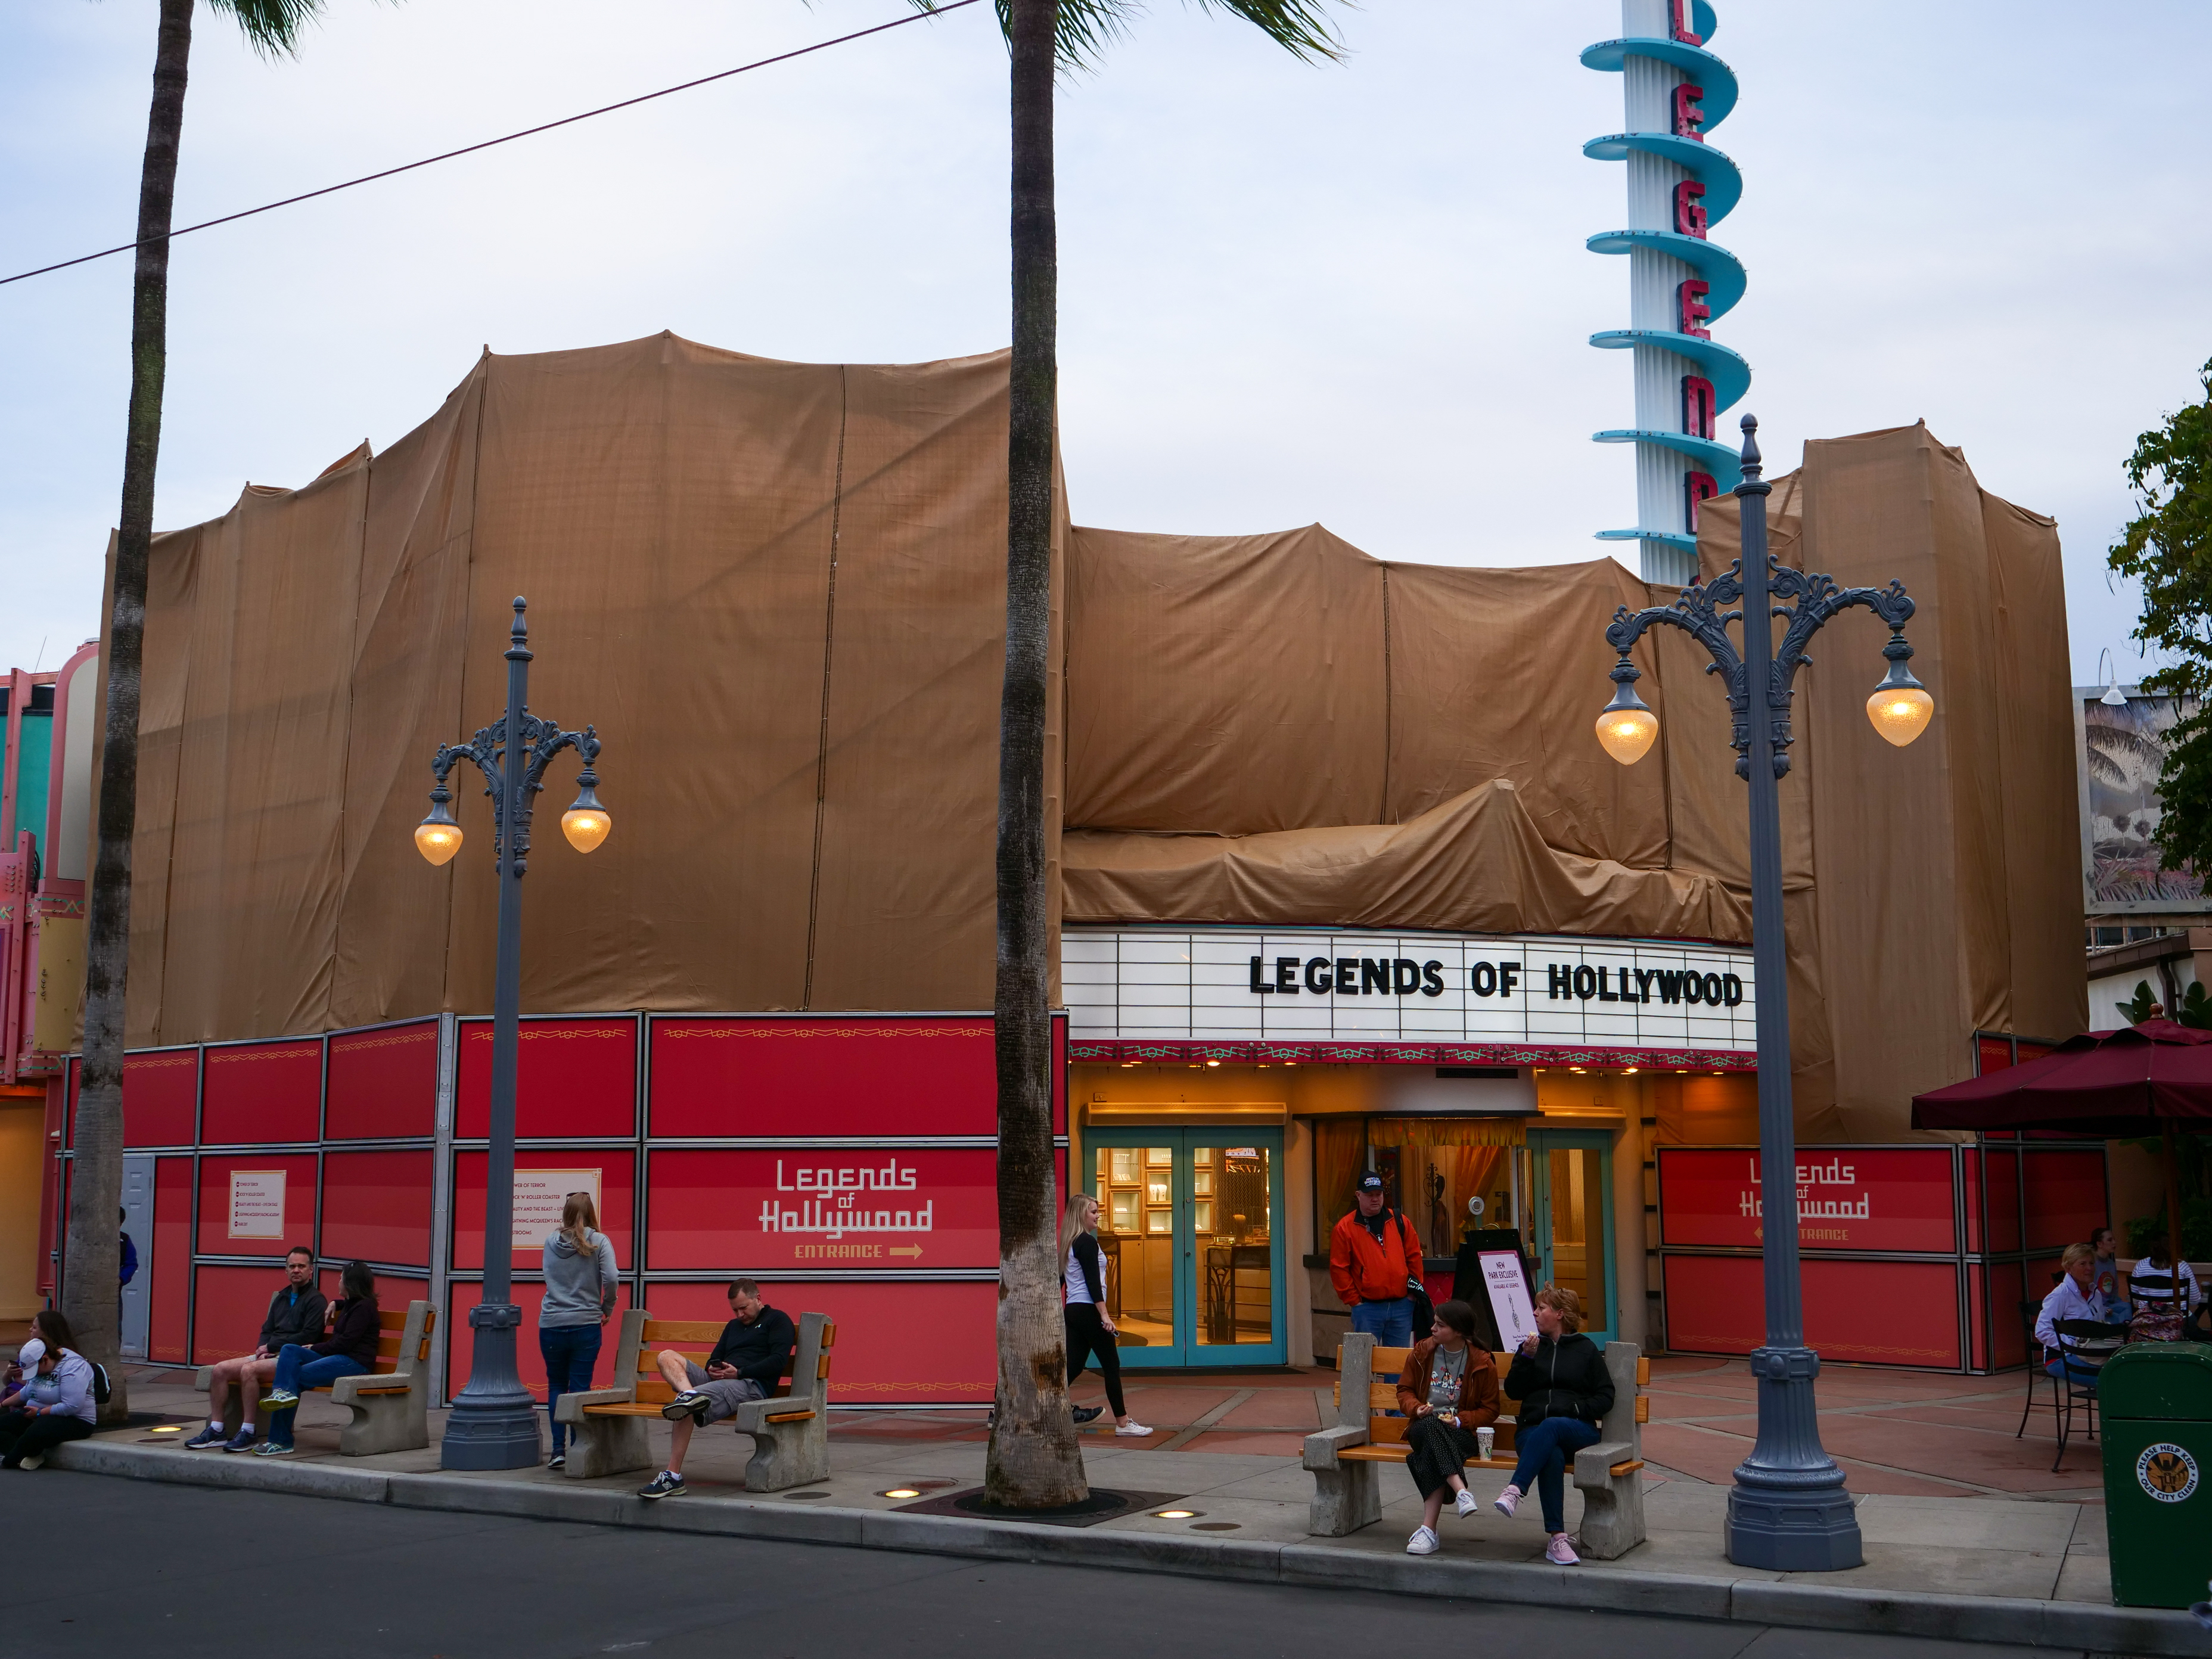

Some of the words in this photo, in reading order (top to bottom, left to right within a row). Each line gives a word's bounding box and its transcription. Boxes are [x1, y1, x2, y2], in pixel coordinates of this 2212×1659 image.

[1669, 0, 1719, 586] LEGEND
[1250, 955, 1444, 998] LEGENDS
[1472, 961, 1521, 998] OF
[1549, 964, 1743, 1008] HOLLYWOOD
[777, 1158, 916, 1198] Legends
[1750, 1157, 1855, 1185] Lends
[838, 1192, 855, 1208] of
[1797, 1185, 1809, 1198] of
[759, 1200, 933, 1239] Hollywood
[1799, 1228, 1849, 1241] TRANCE
[794, 1245, 883, 1258] ENTRANCE
[1488, 1271, 1499, 1279] PARK
[1499, 1270, 1518, 1279] EXCLUSIVE
[2138, 1446, 2158, 1470] PLEASE
[2160, 1445, 2180, 1453] HELP
[2181, 1452, 2195, 1471] KEEP
[2141, 1478, 2155, 1495] OUR
[2157, 1492, 2175, 1500] CITY
[2177, 1479, 2197, 1498] CLEAN
